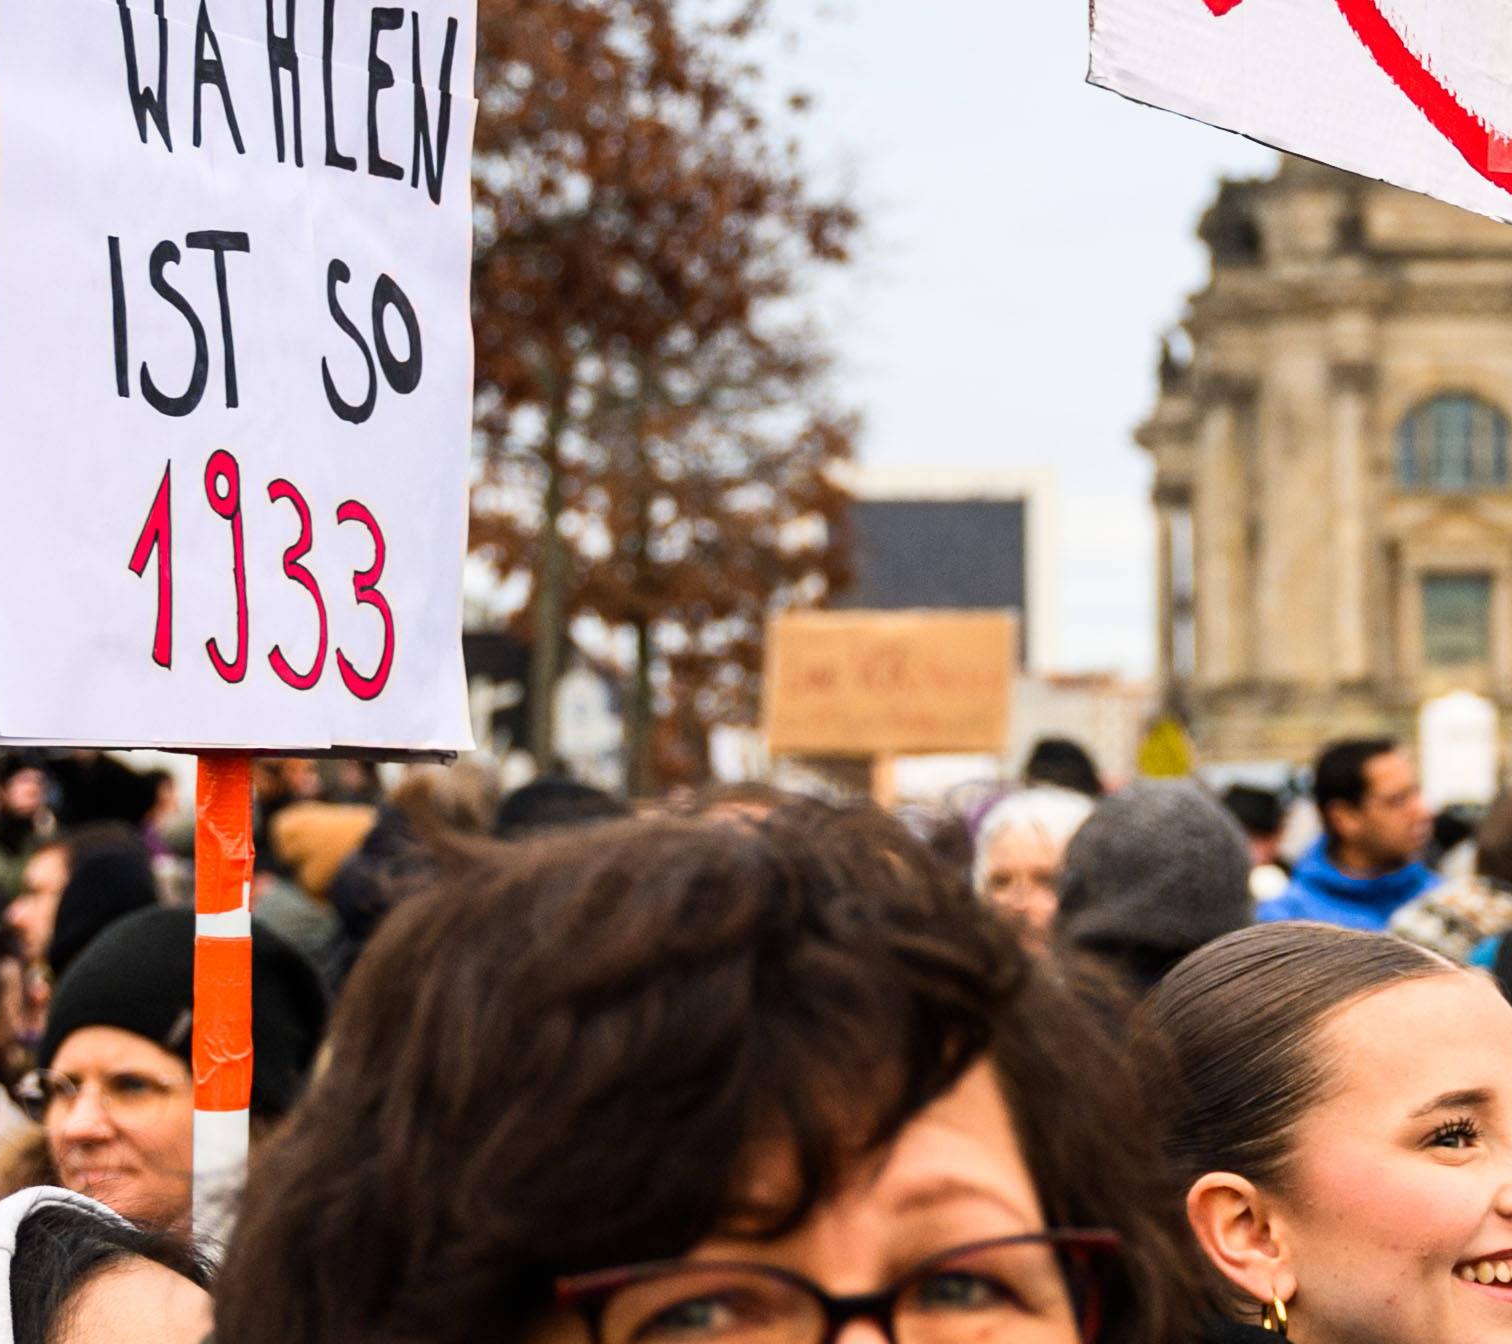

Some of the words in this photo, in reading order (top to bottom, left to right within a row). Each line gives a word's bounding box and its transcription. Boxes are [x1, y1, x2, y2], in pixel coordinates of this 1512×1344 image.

[107, 230, 251, 418] IST
[321, 258, 422, 425] SO
[127, 449, 395, 702] 1933
